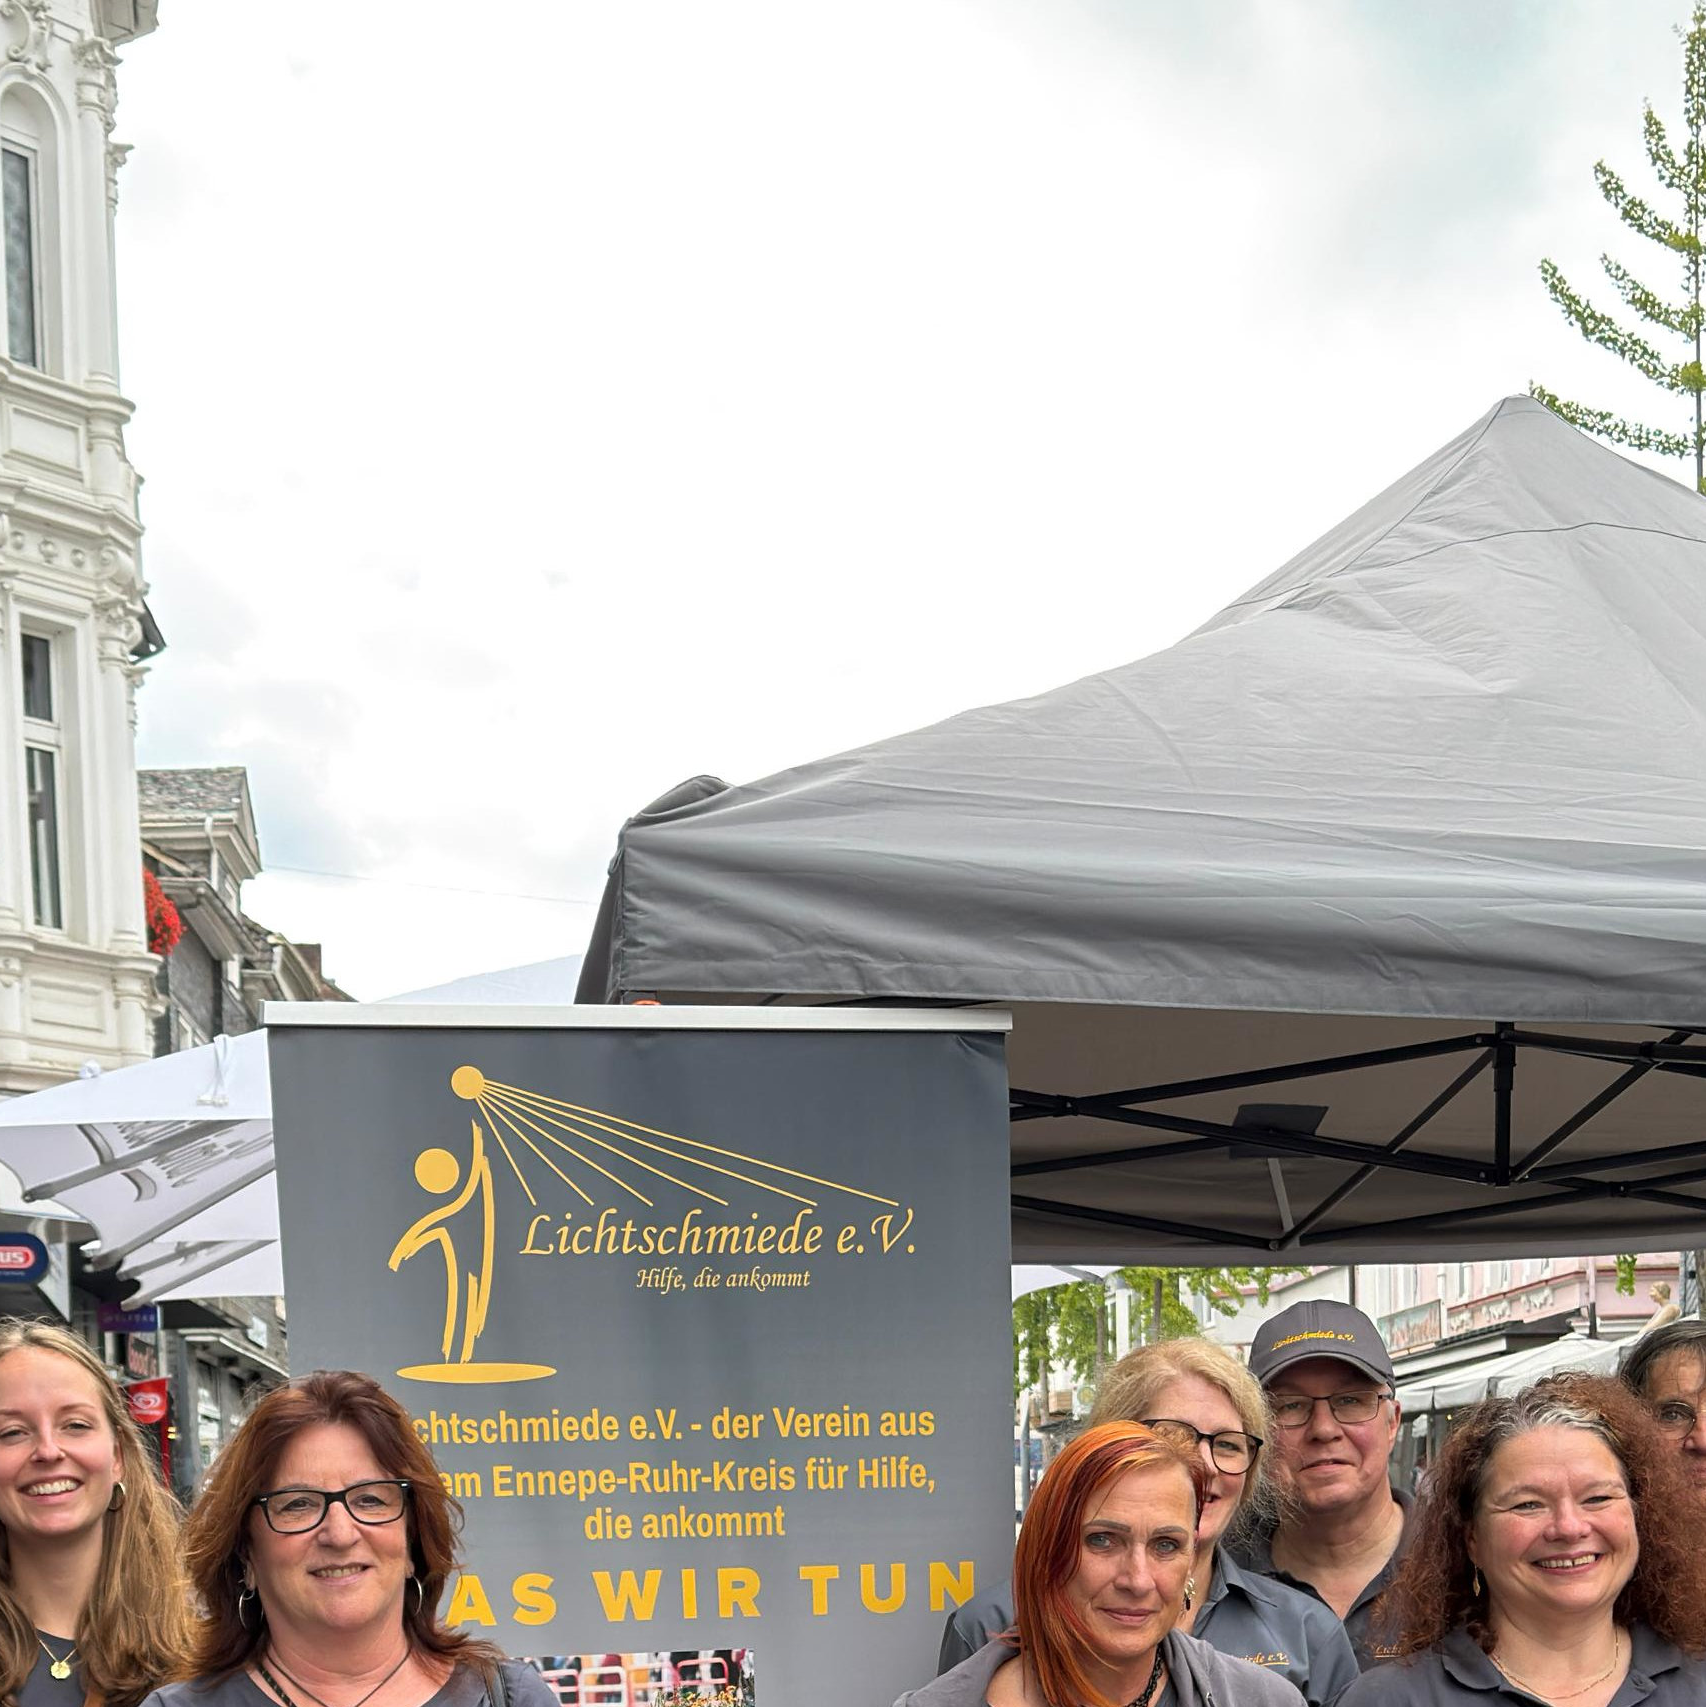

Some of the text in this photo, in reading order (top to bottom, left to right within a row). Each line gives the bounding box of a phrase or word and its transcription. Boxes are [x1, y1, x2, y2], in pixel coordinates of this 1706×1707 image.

[518, 1207, 916, 1255] Lichtschmiede e.V.
[636, 1265, 811, 1295] Hilfe, die ankommt
[412, 1408, 620, 1444] chtschmiede
[629, 1408, 683, 1440] e.V.
[711, 1406, 764, 1439] der
[772, 1404, 871, 1438] Verein
[879, 1409, 935, 1436] aus
[439, 1455, 936, 1501] em Ennepe-Ruhr-Kreis für Hilfe,
[584, 1505, 786, 1540] die ankommt
[445, 1561, 975, 1627] AS WIR TUN
